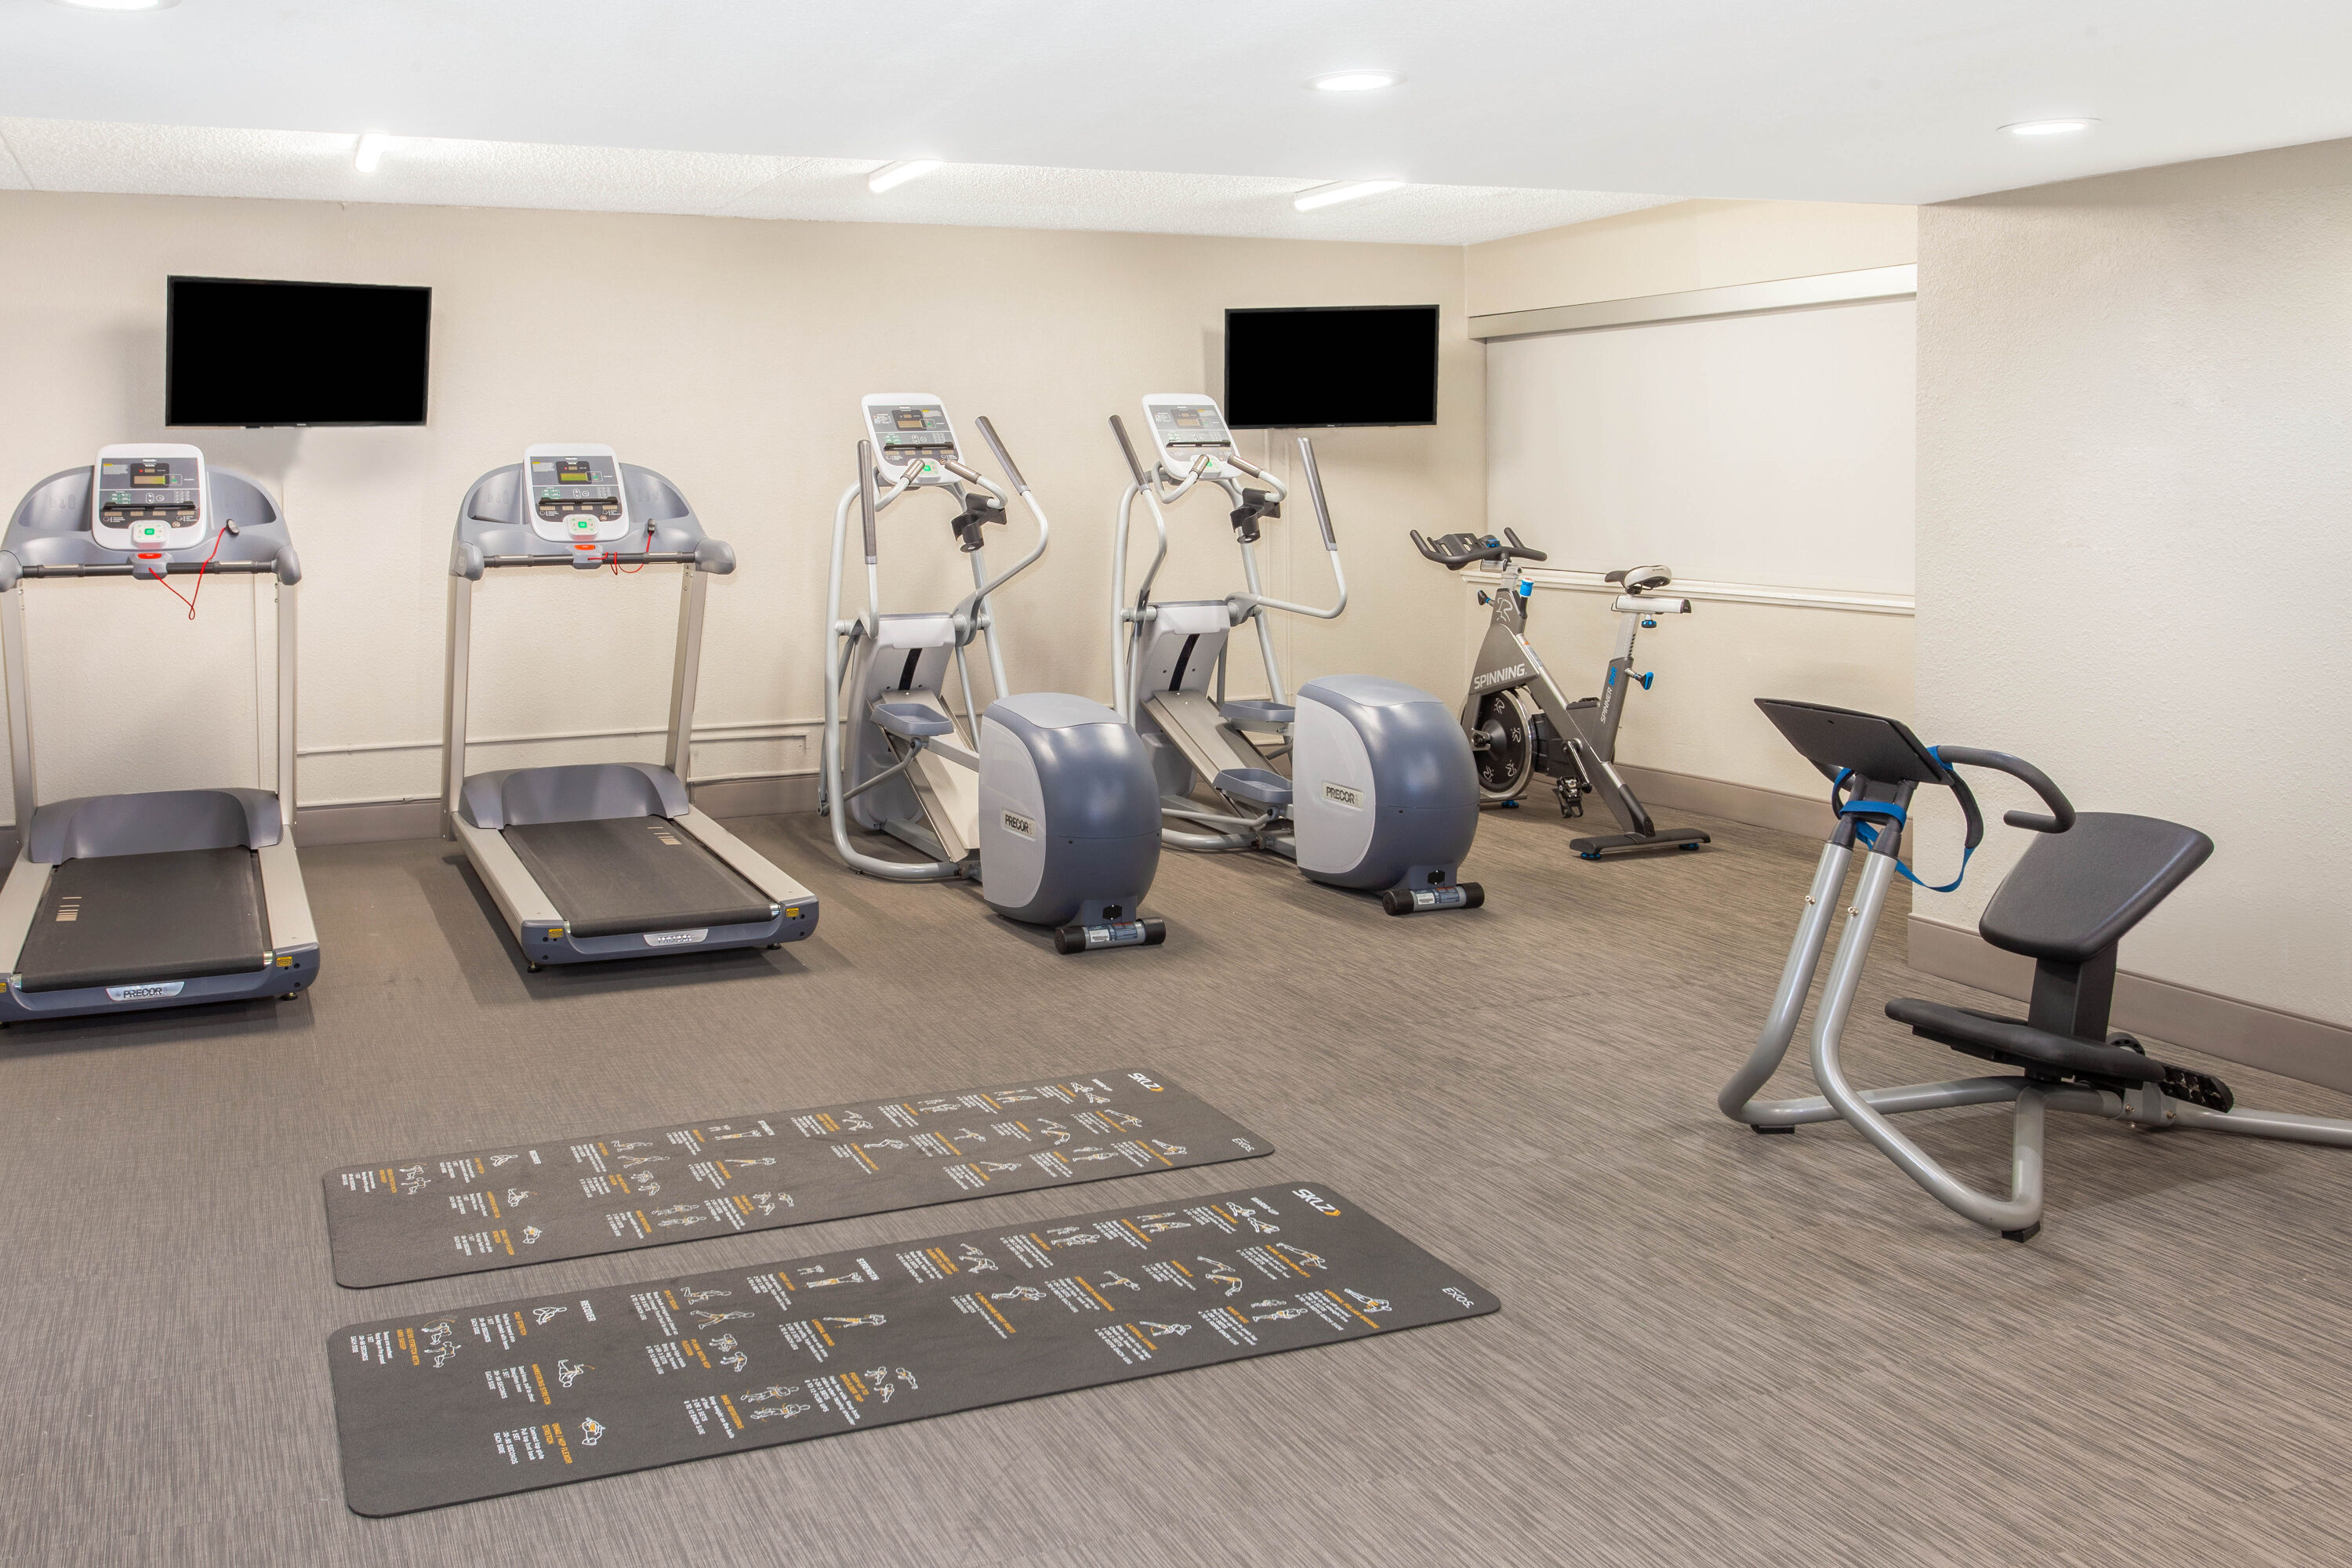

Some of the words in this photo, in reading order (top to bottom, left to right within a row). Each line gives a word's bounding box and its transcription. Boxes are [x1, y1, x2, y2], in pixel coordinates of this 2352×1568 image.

[1473, 662, 1526, 690] SPINNING
[1600, 687, 1613, 724] SPINNER
[1326, 786, 1355, 804] PRECOR
[1004, 814, 1029, 833] PRECOR
[123, 987, 163, 999] PRECOR
[1127, 1073, 1161, 1090] SKLZ
[528, 1150, 542, 1164] RECOVER
[1292, 1189, 1336, 1213] SKLZ
[855, 1258, 880, 1280] STRENGTH
[580, 1300, 597, 1322] RECOVER
[485, 1371, 494, 1381] EACH
[488, 1381, 496, 1390] SIDE
[720, 1394, 732, 1405] BASE
[726, 1405, 745, 1429] ROTATIONS
[493, 1432, 503, 1444] EACH
[542, 1425, 555, 1445] STRETCH
[552, 1423, 563, 1436] QUAD
[561, 1447, 573, 1464] FLEXOR
[496, 1443, 506, 1454] SIDE
